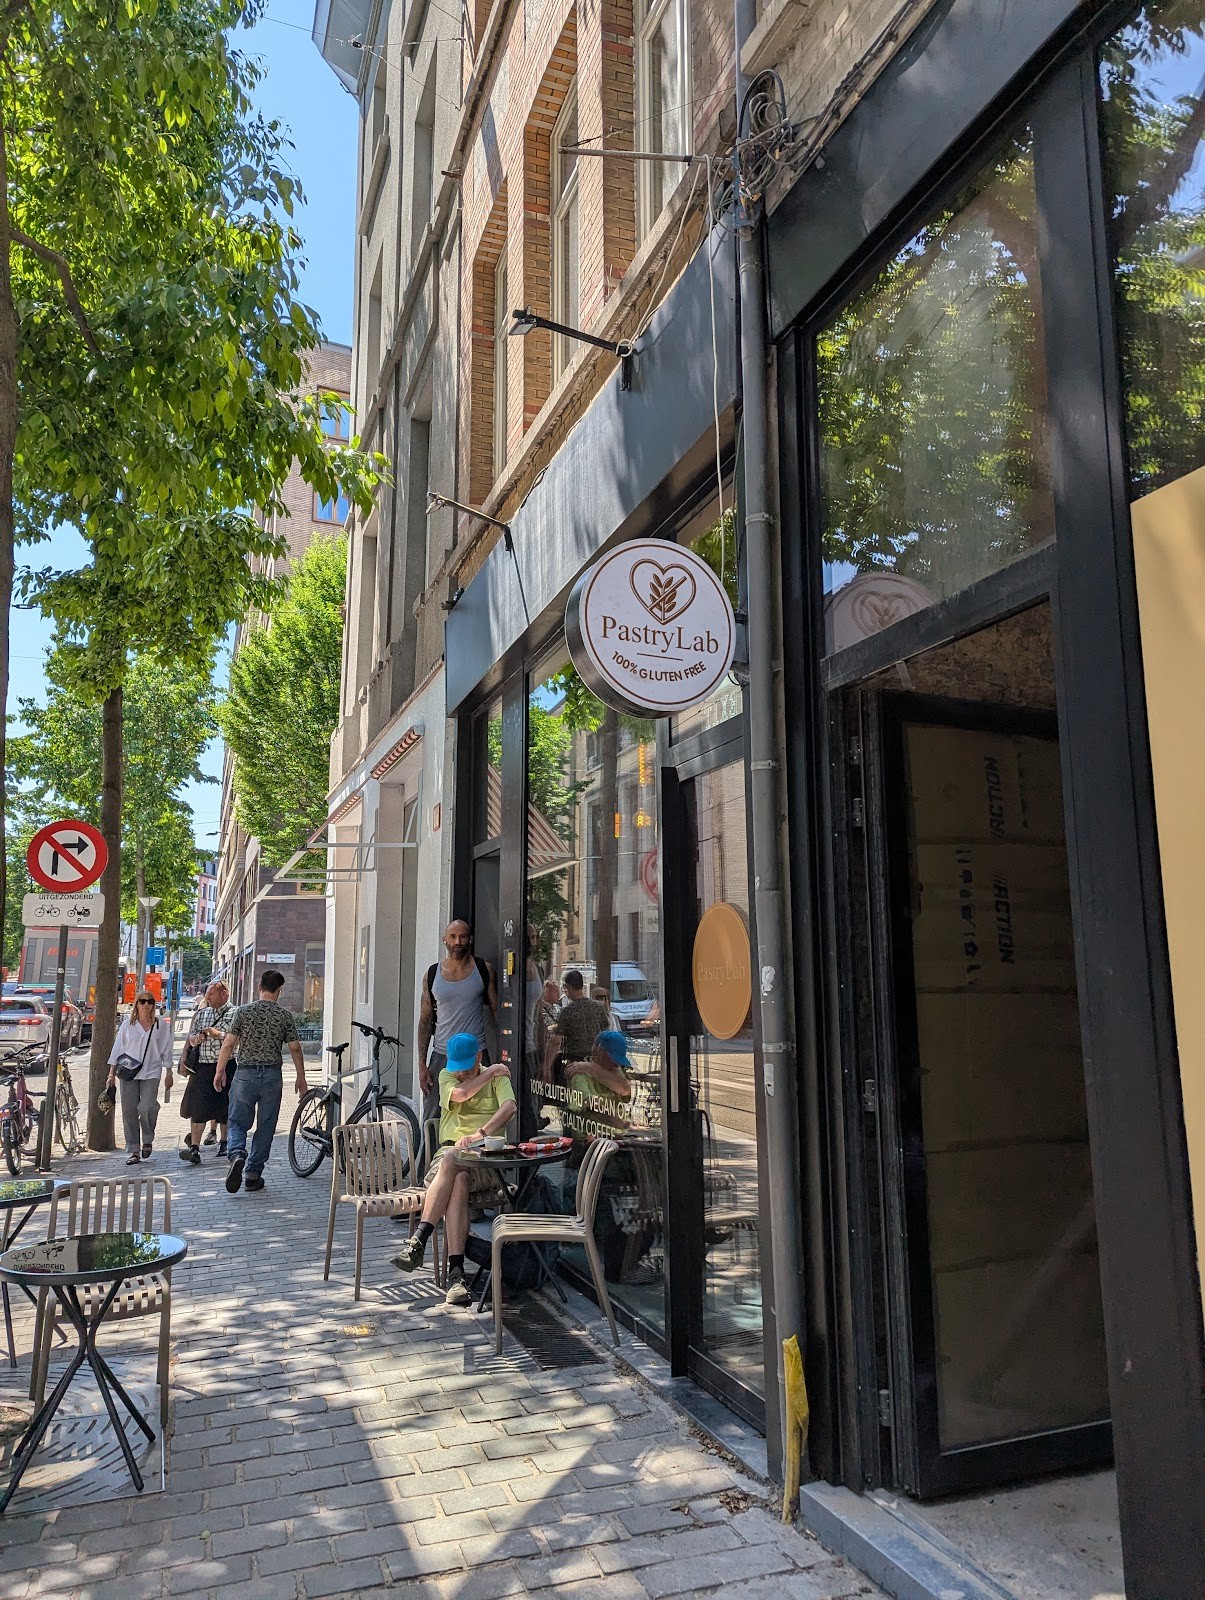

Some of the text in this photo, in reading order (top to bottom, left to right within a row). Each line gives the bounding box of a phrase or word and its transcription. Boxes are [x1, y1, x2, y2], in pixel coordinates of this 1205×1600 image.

[601, 615, 719, 654] PastryLab
[611, 651, 707, 682] 100% GLUTEN FREE
[994, 884, 1015, 965] ACTION
[529, 1078, 545, 1097] 100%
[544, 1083, 583, 1108] GLUTENVRIJ
[588, 1093, 616, 1117] VEGAN
